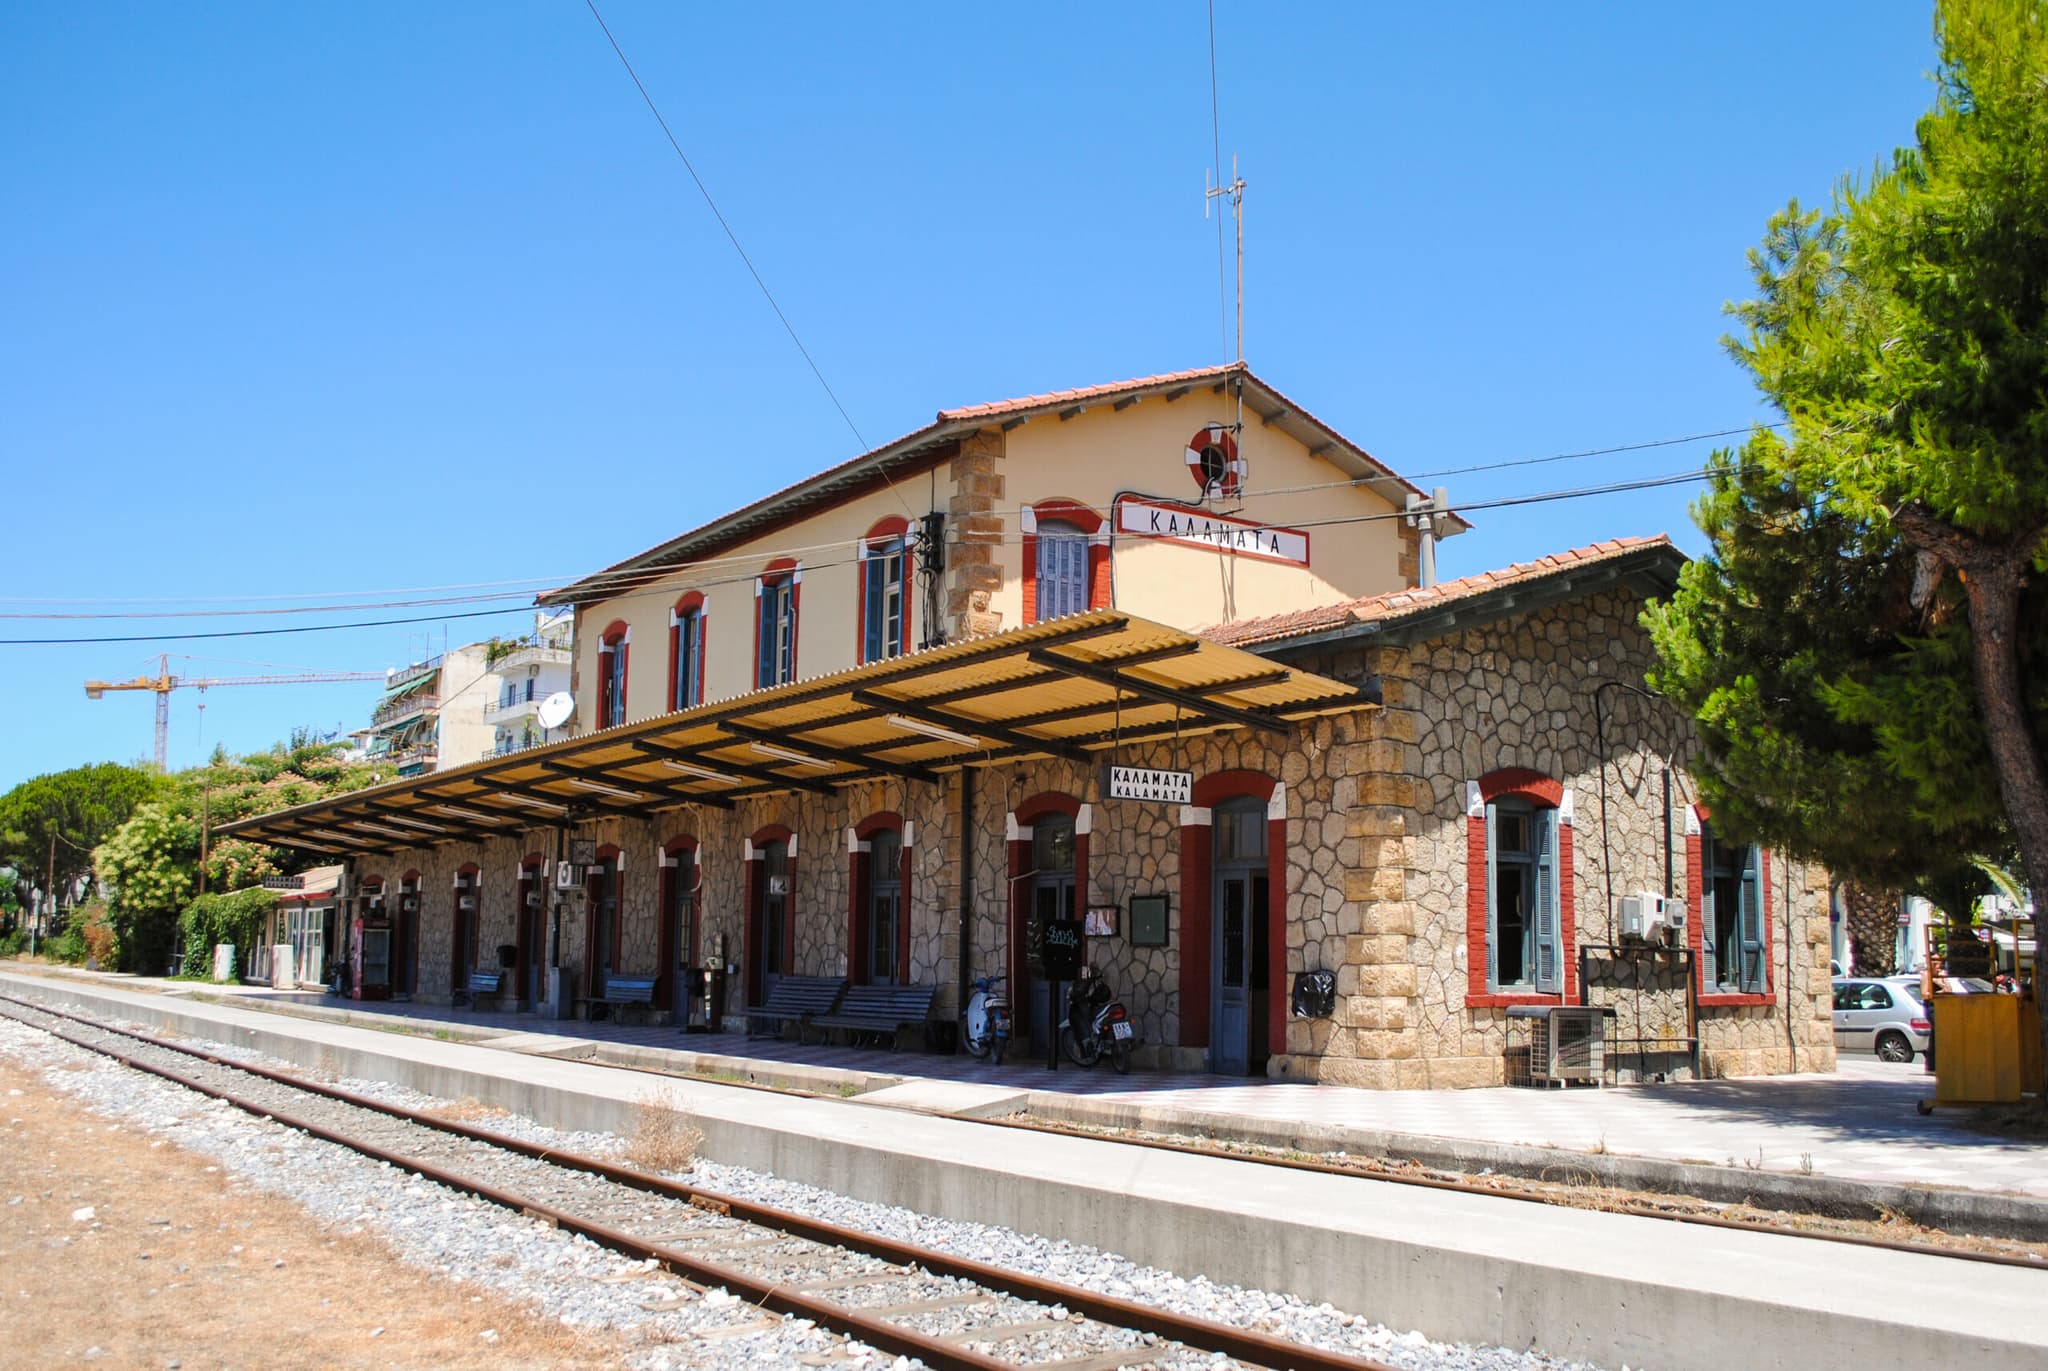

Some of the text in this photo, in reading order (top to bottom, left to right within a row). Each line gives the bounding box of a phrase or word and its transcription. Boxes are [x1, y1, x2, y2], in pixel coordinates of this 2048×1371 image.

[1151, 510, 1279, 553] ΚΑΛΑΜΑΤΑ
[1113, 769, 1188, 788] ΚΑΛΑΜΑΤΑ
[1116, 785, 1185, 800] KALAMATA
